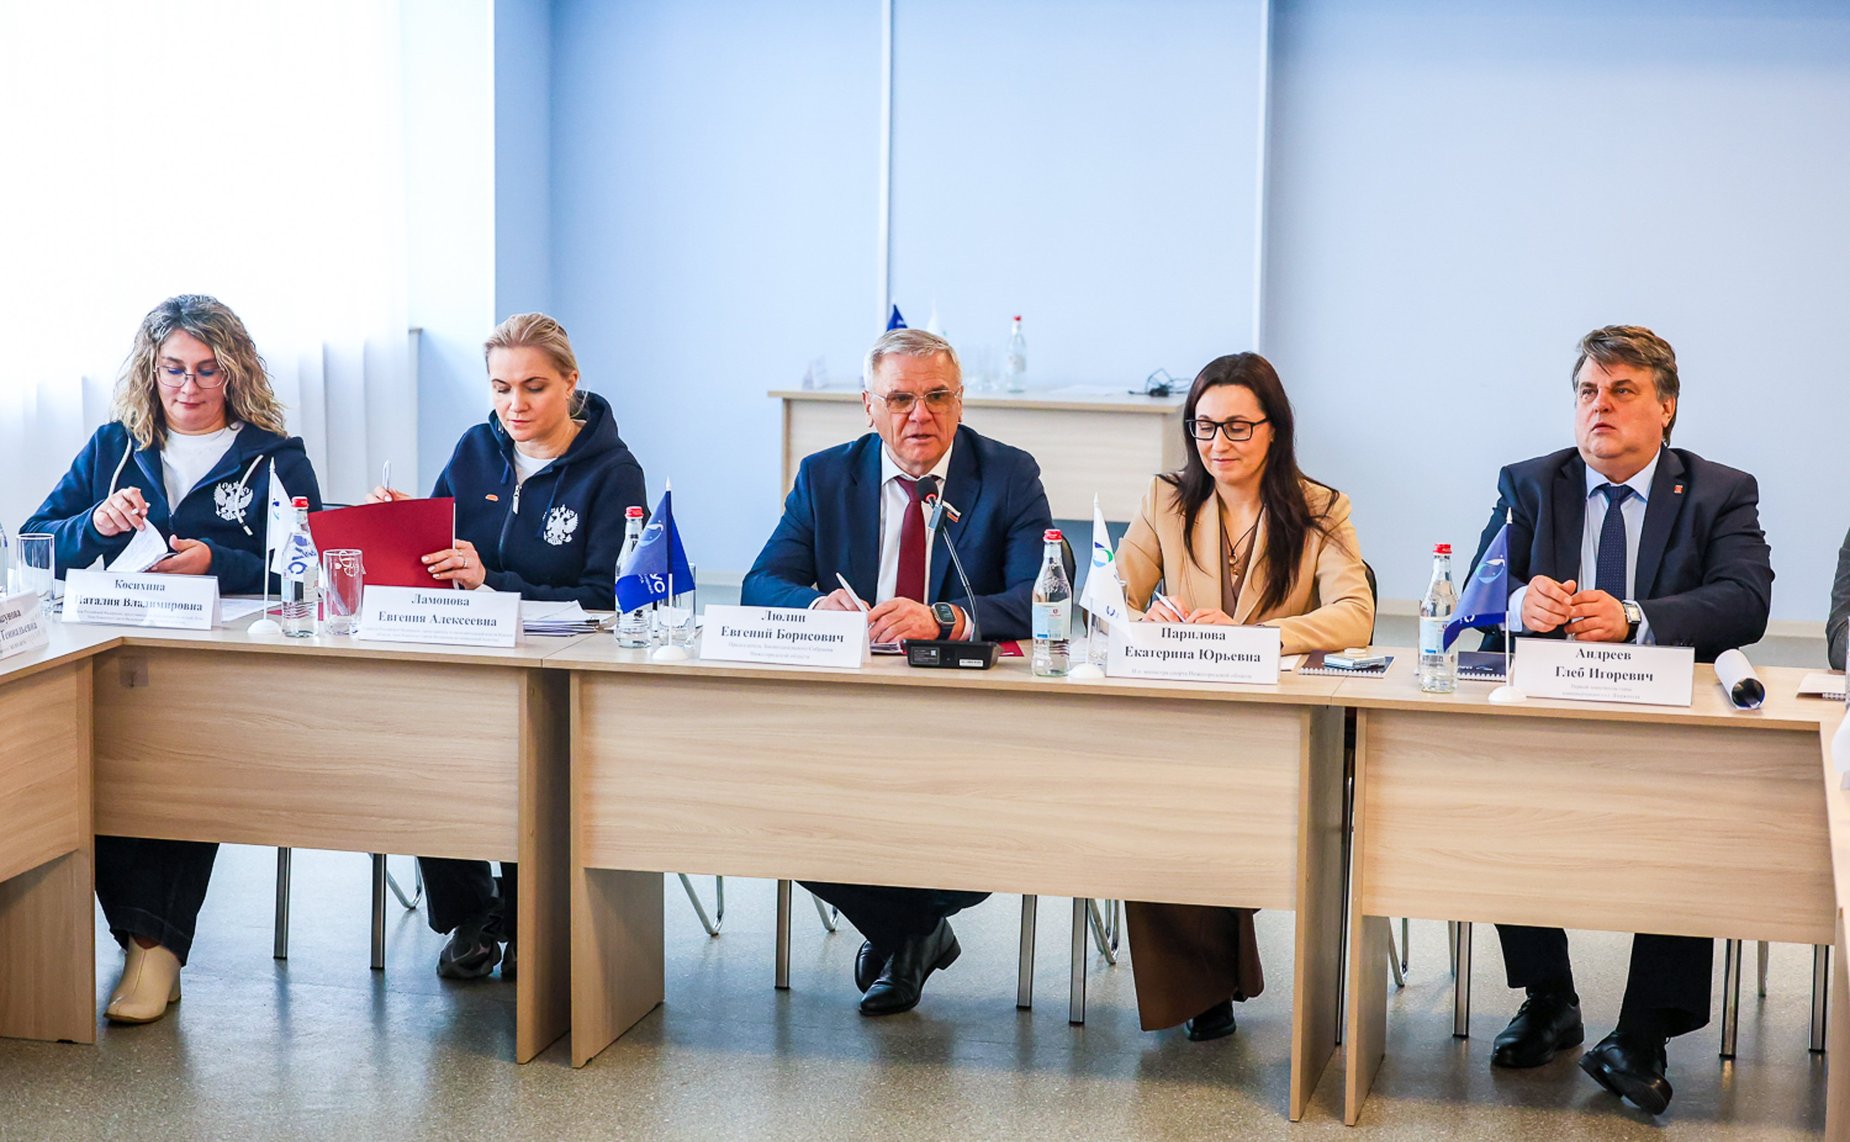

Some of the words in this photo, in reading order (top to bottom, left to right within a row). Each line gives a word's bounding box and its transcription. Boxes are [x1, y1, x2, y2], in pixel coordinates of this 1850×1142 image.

[115, 579, 166, 592] Косихина
[123, 598, 203, 612] Владимировна
[411, 593, 470, 606] Ламонова
[378, 611, 426, 624] Евгения
[429, 613, 497, 627] Алексеевна
[761, 610, 806, 623] Люлин
[721, 626, 773, 639] Евгений
[776, 628, 844, 643] Борисович
[1161, 627, 1226, 642] Парилова
[1125, 646, 1195, 661] Екатерина
[1199, 648, 1261, 663] Юрьевна
[1576, 648, 1632, 662] Андреев
[1555, 666, 1585, 678] Глеб
[1589, 668, 1654, 683] Игоревич
